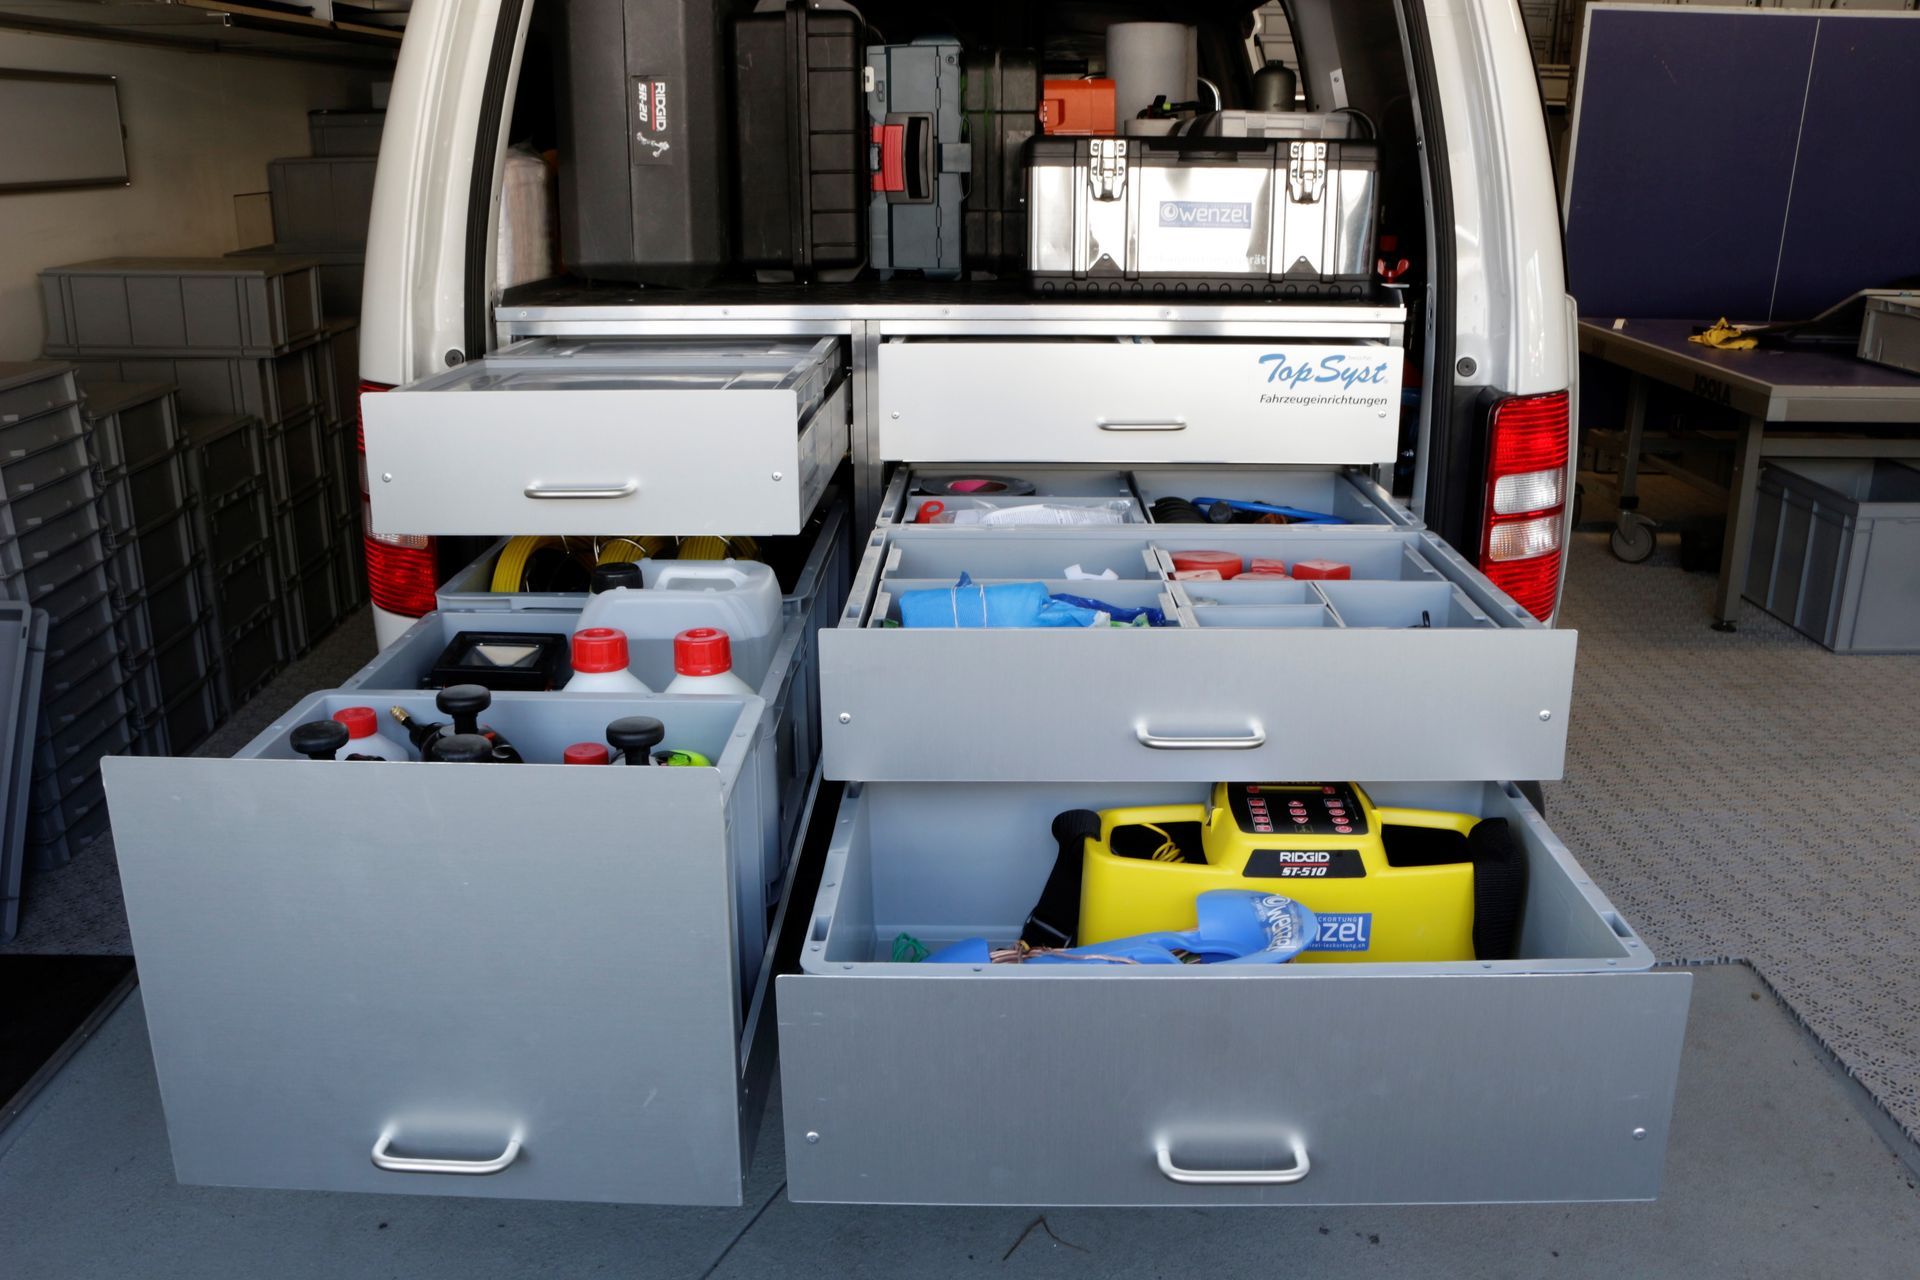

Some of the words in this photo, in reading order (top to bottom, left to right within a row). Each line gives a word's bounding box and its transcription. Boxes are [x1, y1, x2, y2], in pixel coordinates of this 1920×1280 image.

[638, 82, 648, 122] SR-20
[655, 82, 666, 131] RIDGID
[1179, 203, 1249, 223] wenzel
[1258, 353, 1388, 390] TopSyst
[1260, 394, 1388, 407] Fahrzeugeinrichtungen
[1280, 852, 1330, 863] RIDGID
[1281, 867, 1327, 876] ST-510
